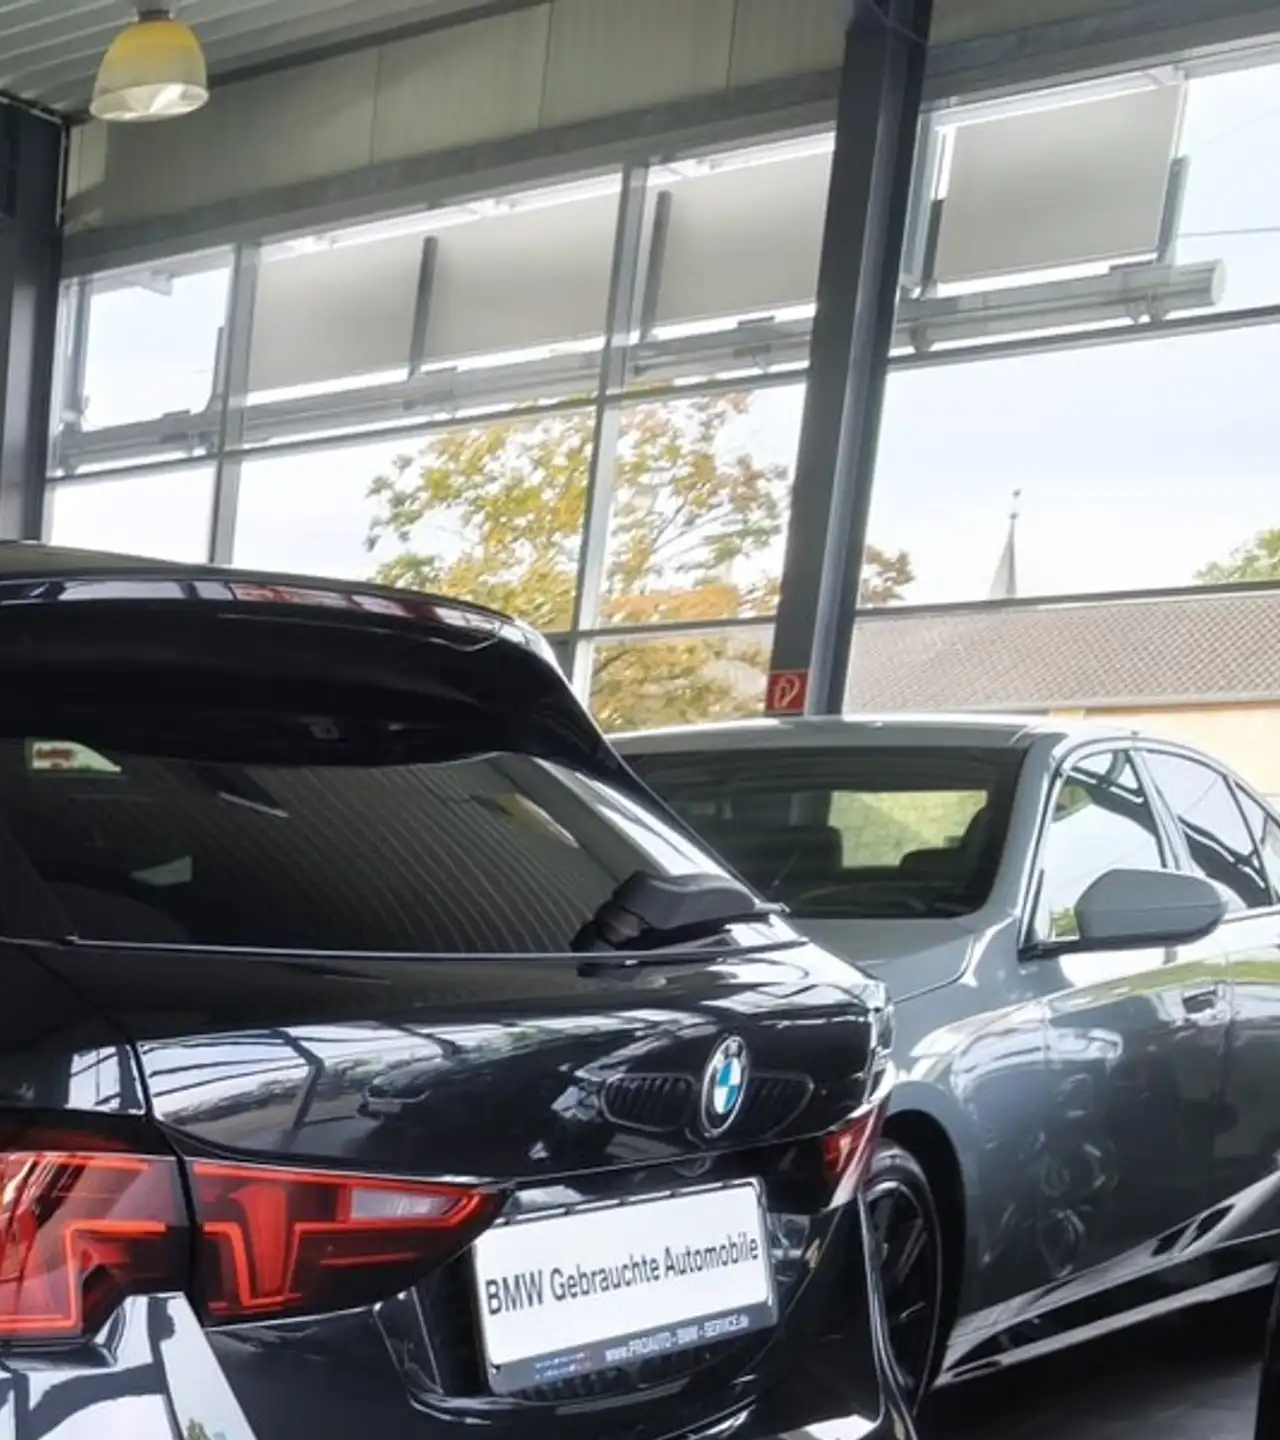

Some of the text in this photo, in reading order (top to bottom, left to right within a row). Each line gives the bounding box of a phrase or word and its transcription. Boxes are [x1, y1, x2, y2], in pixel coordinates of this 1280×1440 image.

[485, 1233, 760, 1316] BMW Gebrauchte Automobile
